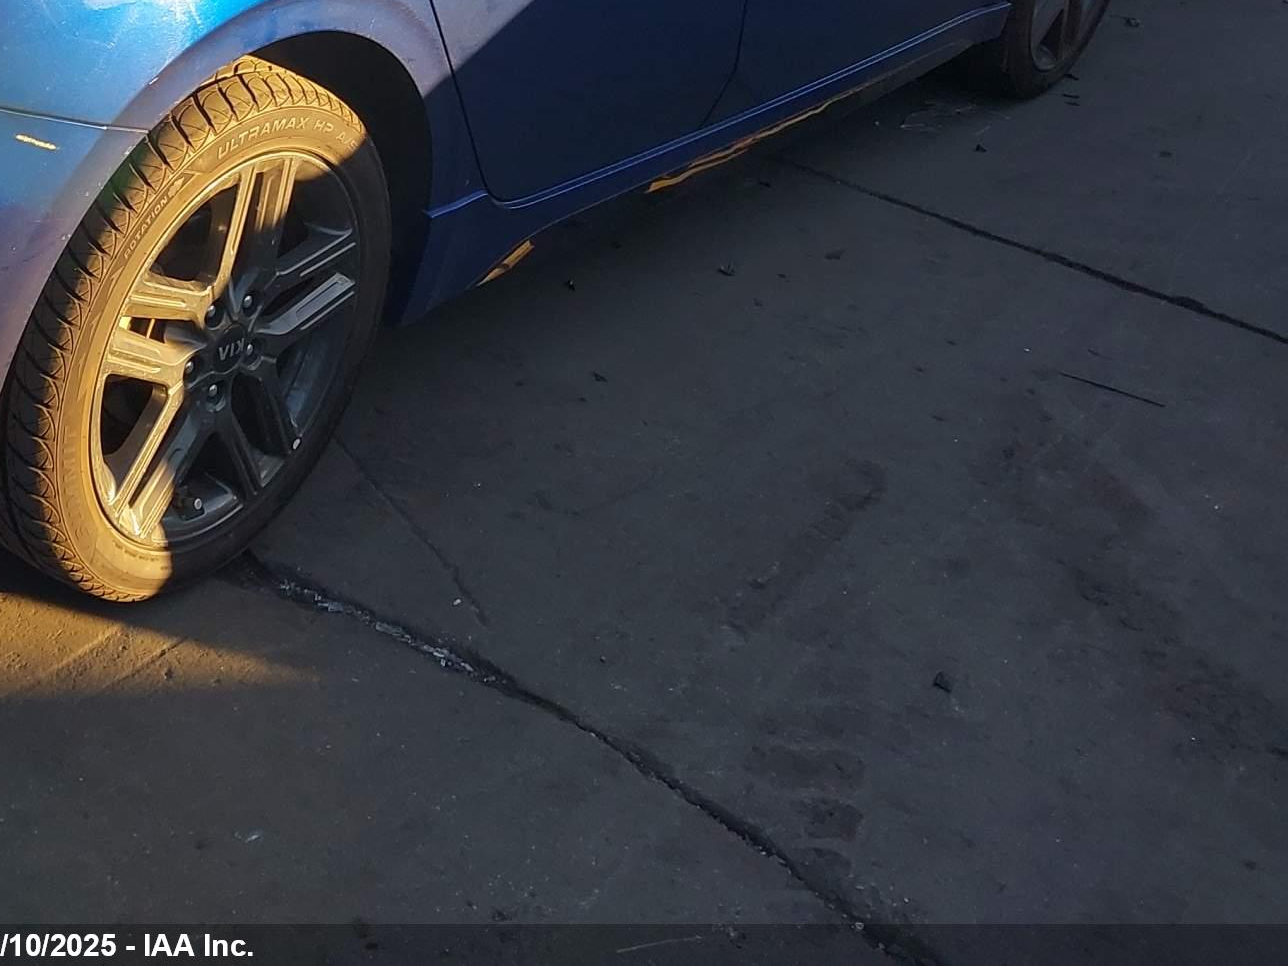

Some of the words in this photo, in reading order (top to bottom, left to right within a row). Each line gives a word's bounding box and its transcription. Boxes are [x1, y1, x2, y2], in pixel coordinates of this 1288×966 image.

[217, 117, 309, 159] ULTRAMAX
[313, 119, 334, 135] HP
[123, 199, 169, 259] ROTATION
[218, 337, 246, 361] KIA
